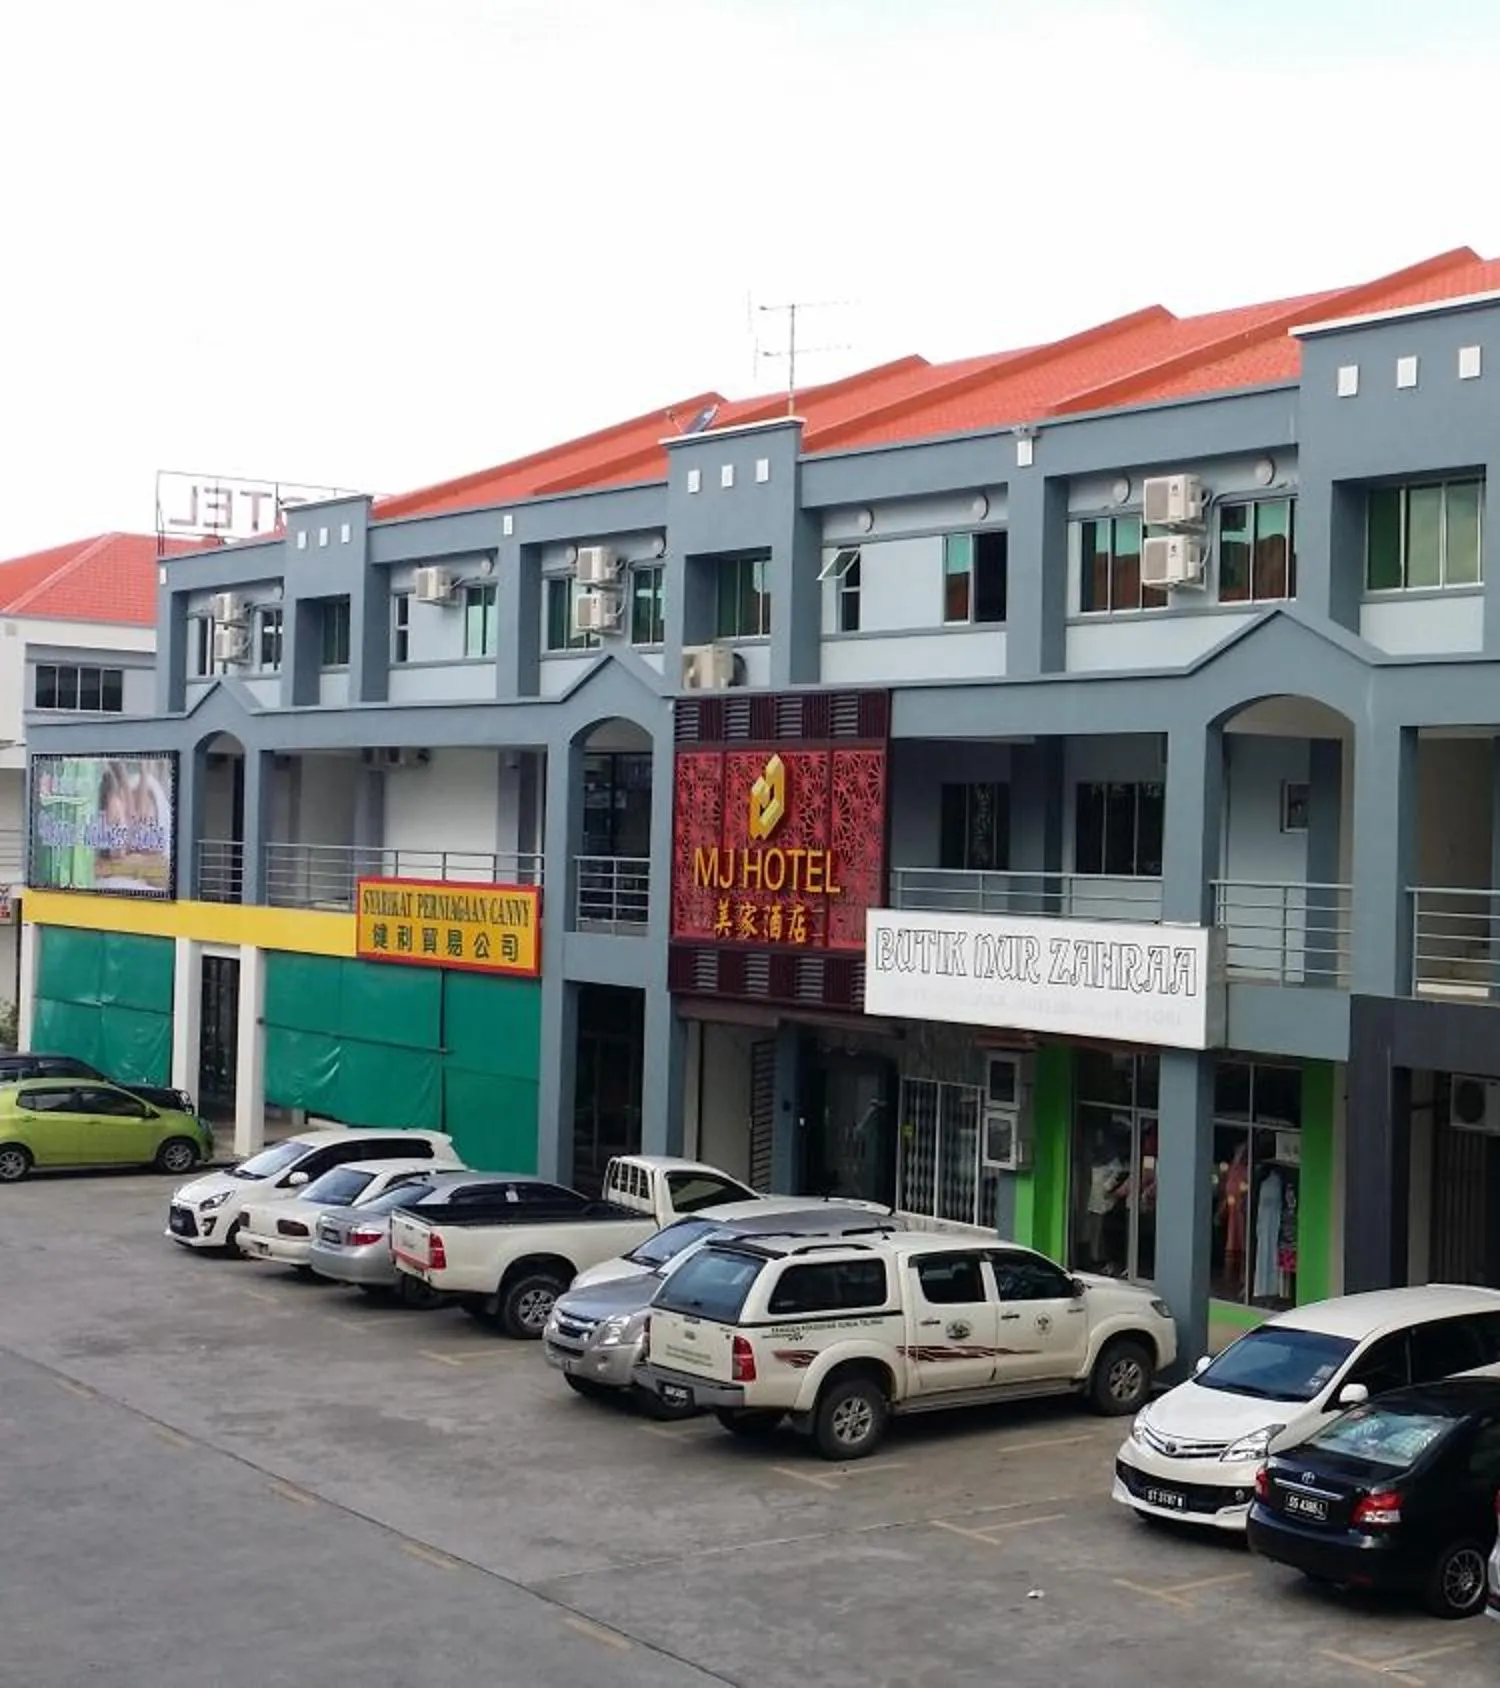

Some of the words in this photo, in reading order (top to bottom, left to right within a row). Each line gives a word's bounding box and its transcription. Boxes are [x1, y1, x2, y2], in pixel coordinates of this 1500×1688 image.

[695, 847, 735, 889] MJ
[743, 848, 841, 893] HOTEL
[363, 889, 413, 918] SYARIKAT
[416, 893, 488, 924] PERNIAGAAN
[489, 897, 532, 928] CANNY
[714, 898, 808, 943] 美家酒店
[875, 927, 969, 977] BUTIK
[974, 932, 1041, 985] NUR
[1047, 937, 1198, 997] ZAHRAA
